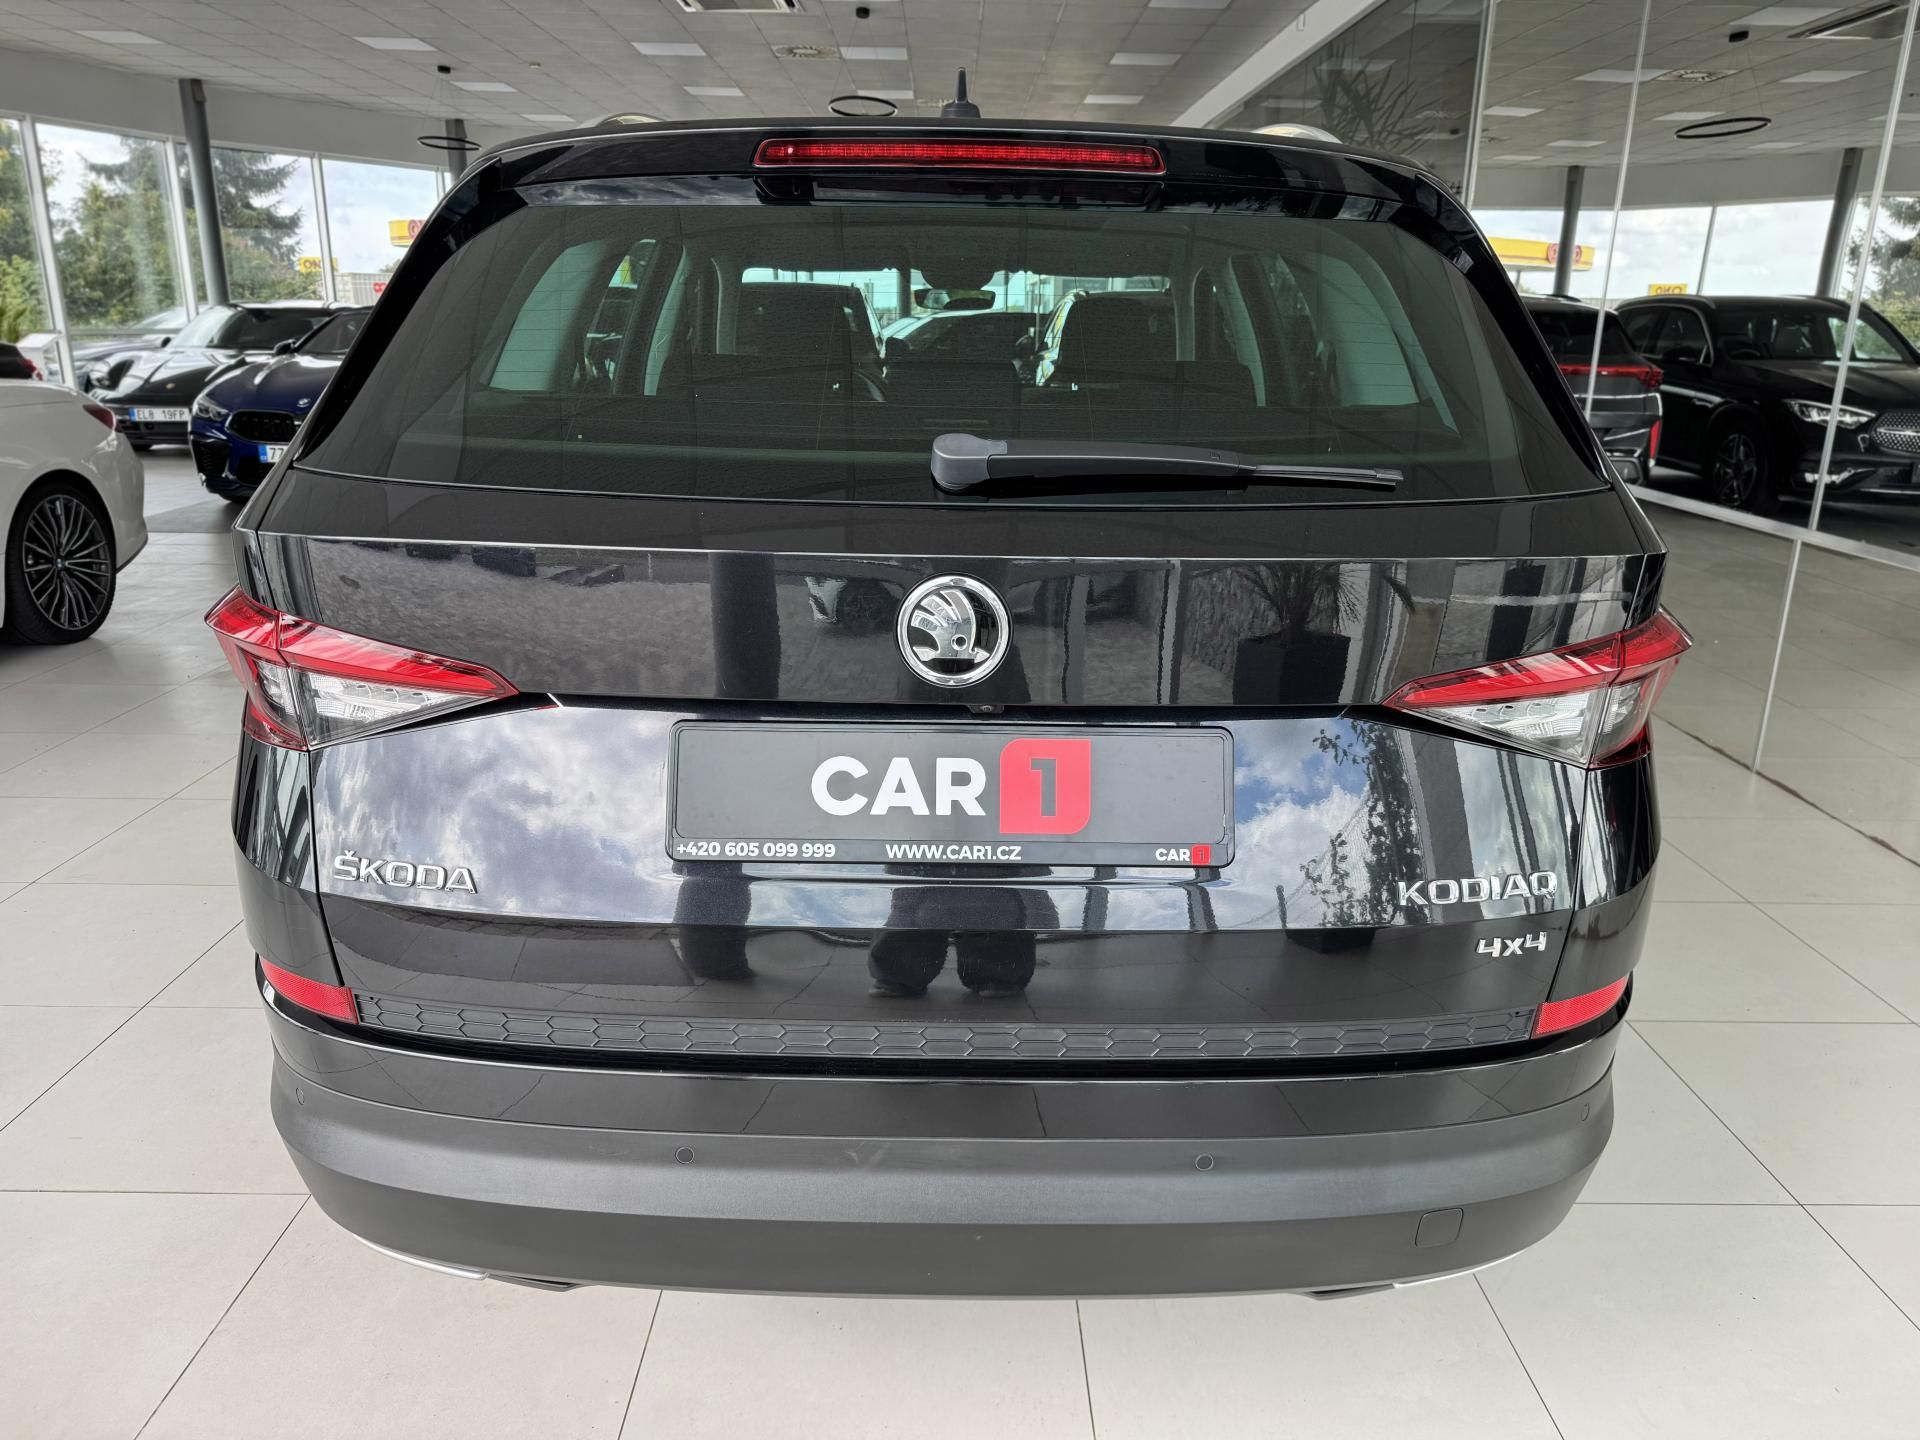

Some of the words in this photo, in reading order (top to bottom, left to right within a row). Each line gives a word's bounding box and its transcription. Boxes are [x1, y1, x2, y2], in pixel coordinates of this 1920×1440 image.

[811, 755, 986, 816] CAR
[1031, 759, 1057, 817] 1
[676, 841, 721, 856] +420
[724, 842, 759, 857] 605
[762, 843, 798, 857] 099
[801, 843, 836, 858] 999
[885, 844, 1022, 861] WWW.CAR1.CZ
[1155, 848, 1190, 862] CAR
[334, 850, 478, 894] ŠKODA
[1397, 871, 1558, 906] KODIAQ
[1476, 931, 1548, 958] 4x4
